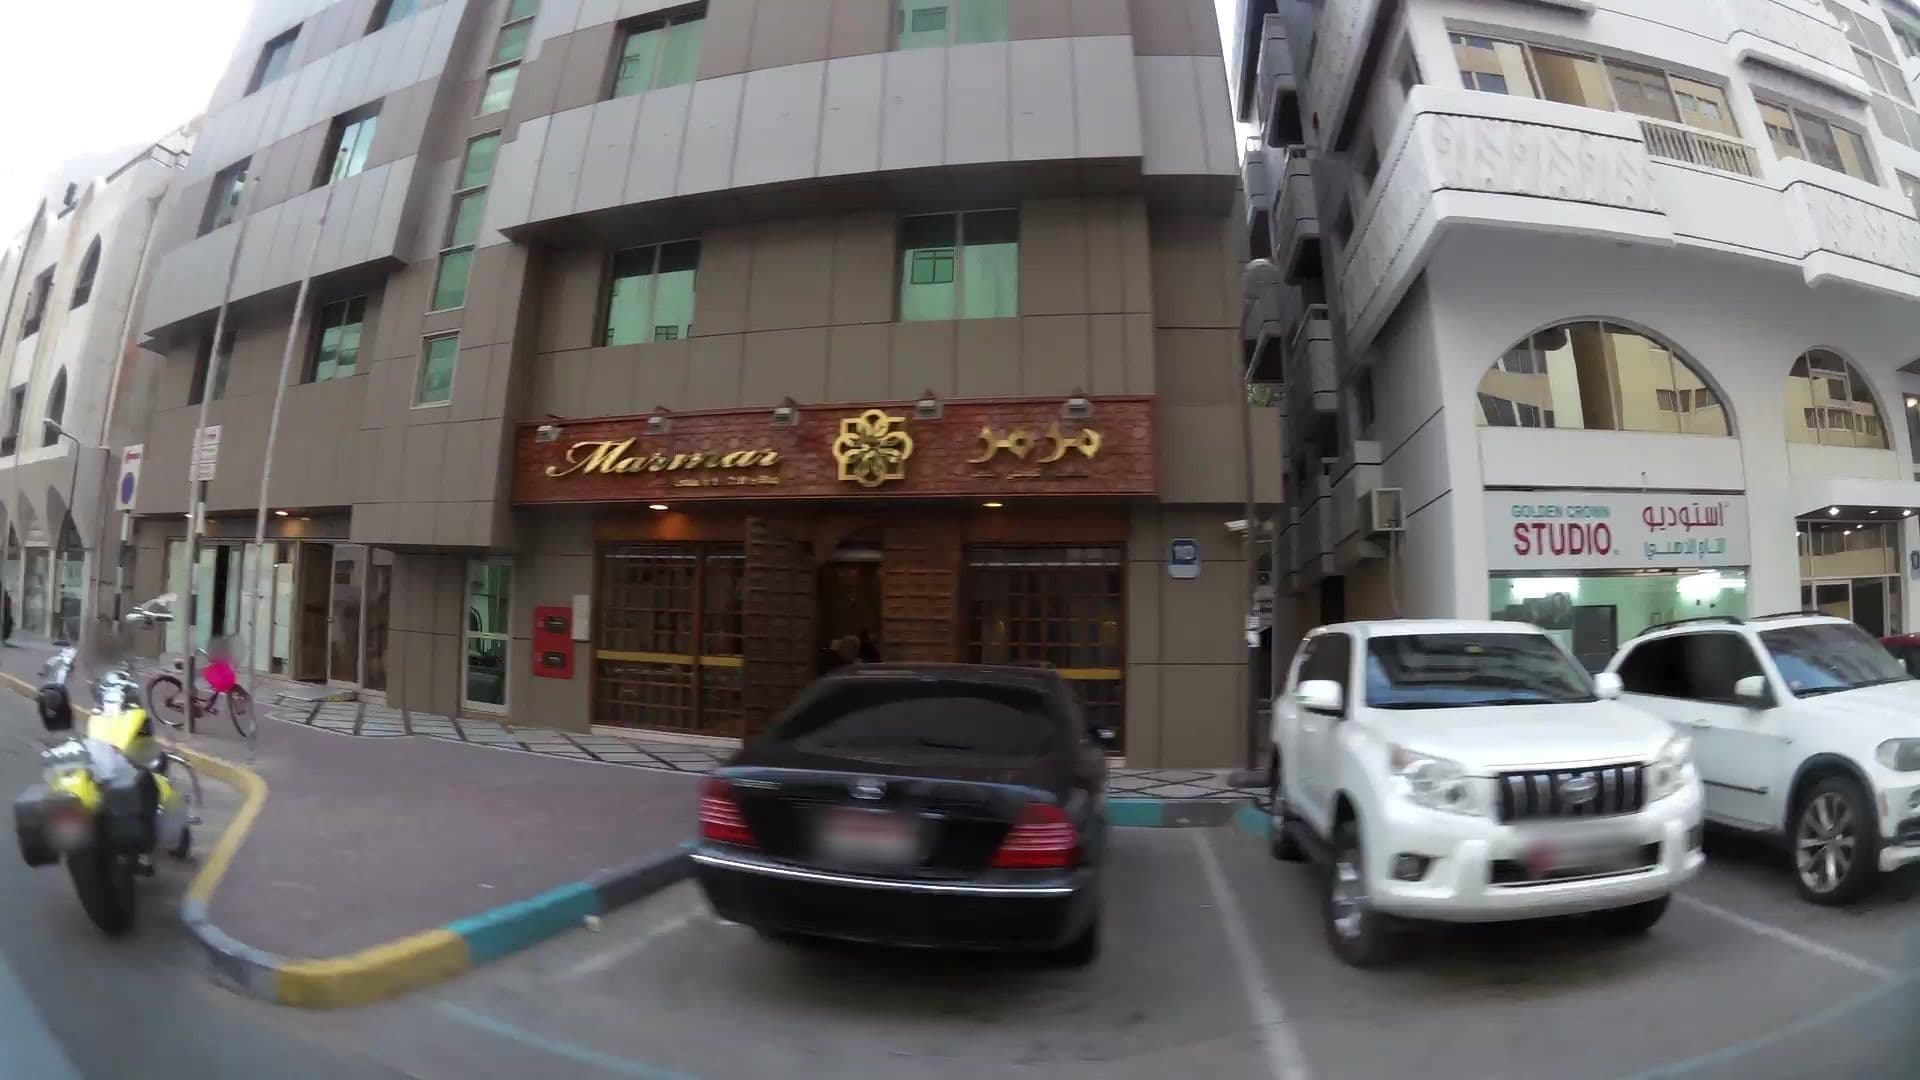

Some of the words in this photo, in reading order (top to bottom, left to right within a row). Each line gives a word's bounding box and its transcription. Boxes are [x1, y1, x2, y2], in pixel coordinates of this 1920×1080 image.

[546, 437, 778, 477] Marmar
[1512, 505, 1562, 517] GOLDEN
[1642, 502, 1723, 532] استوديو
[1514, 522, 1611, 555] STUDIO
